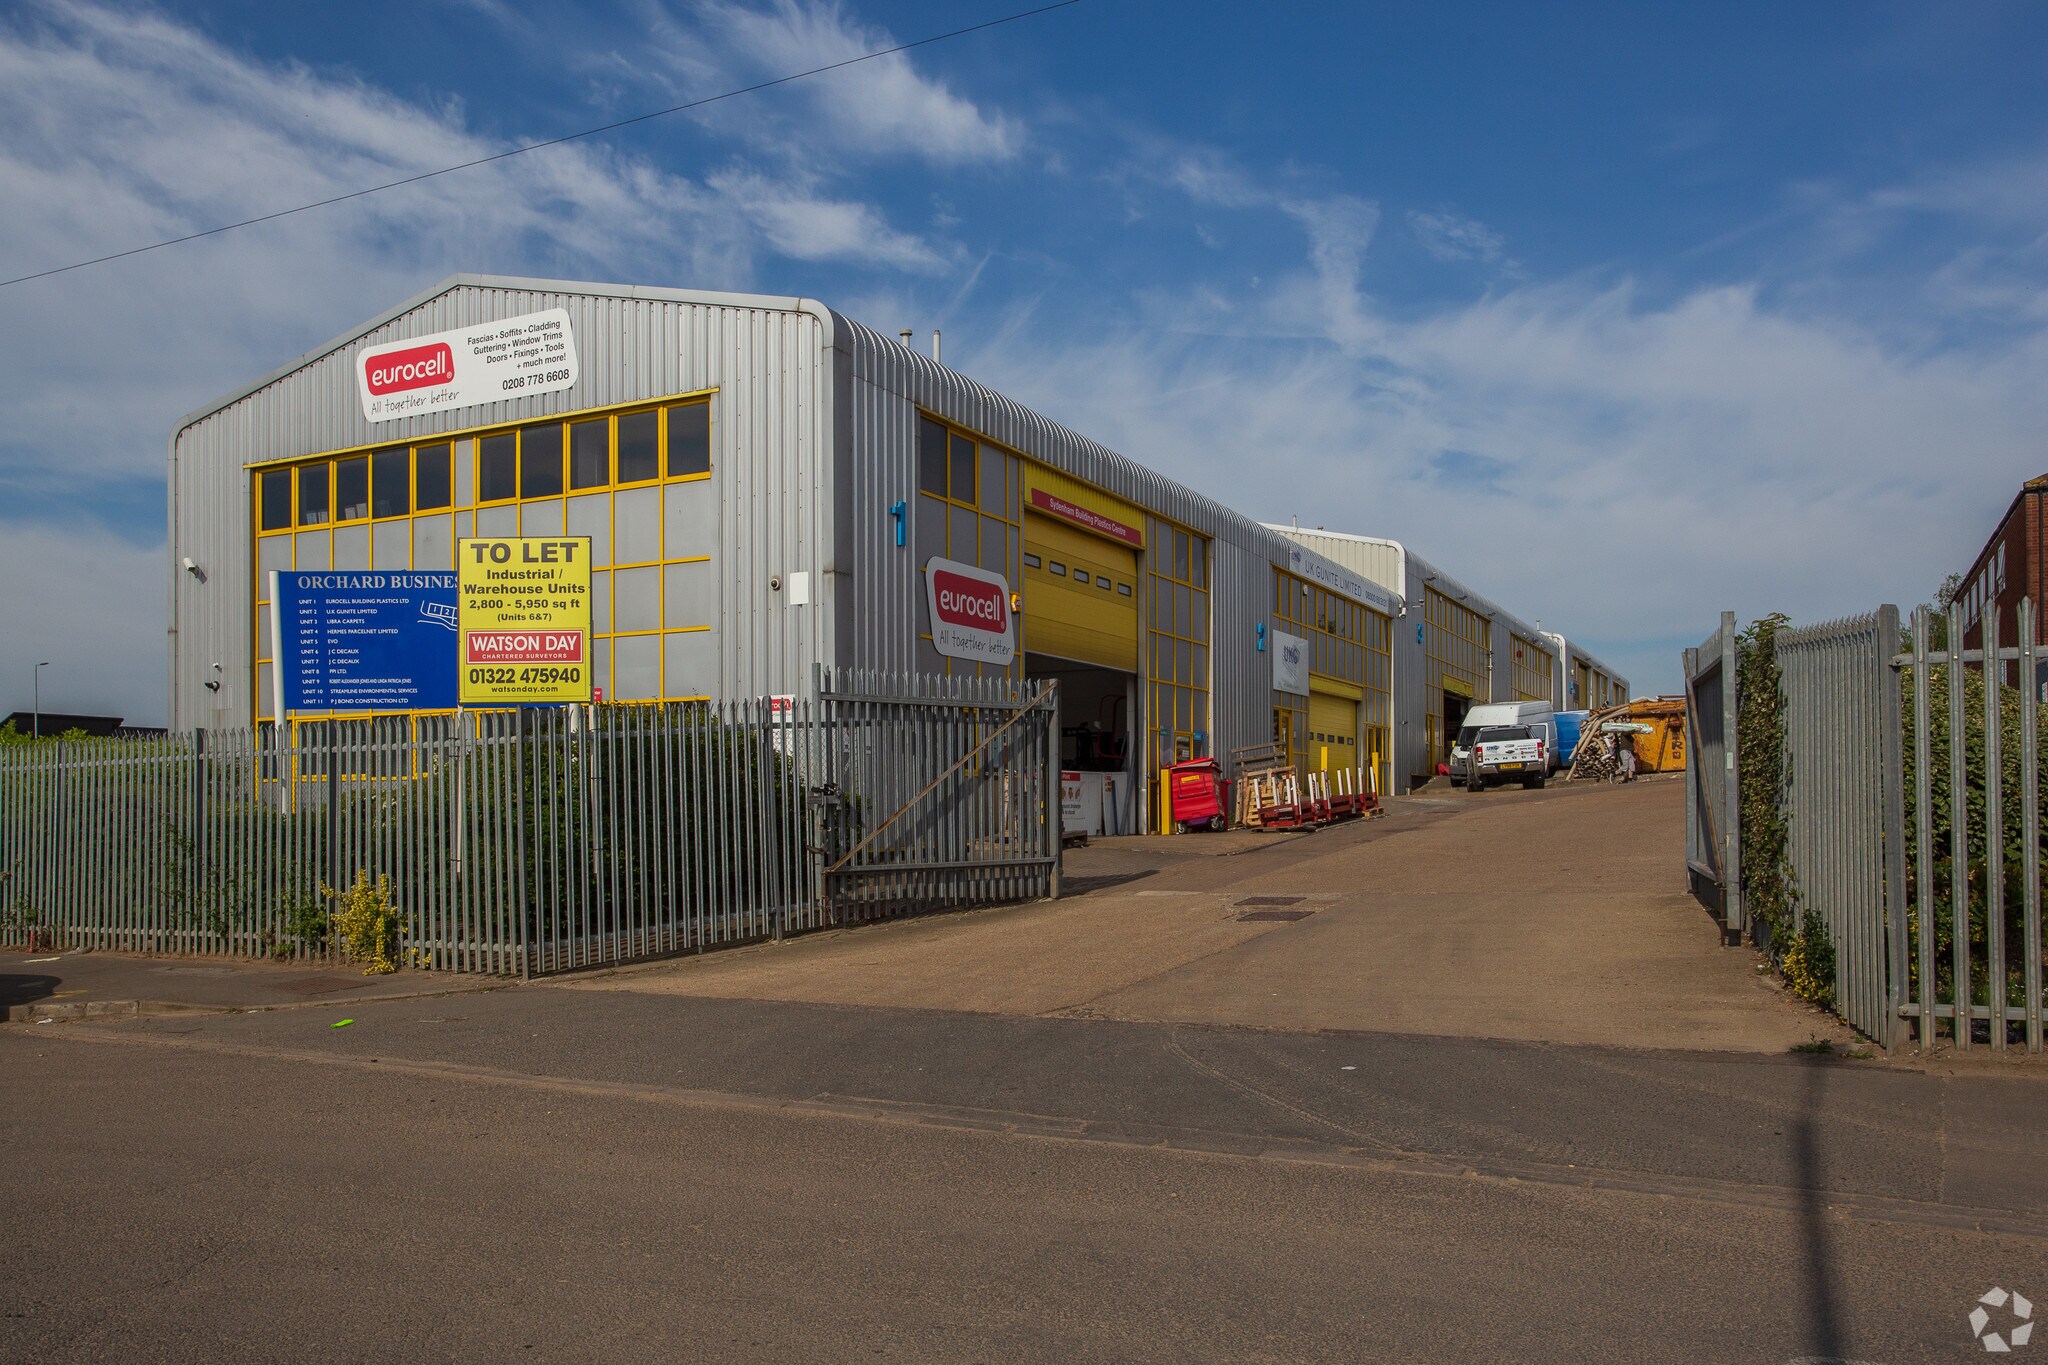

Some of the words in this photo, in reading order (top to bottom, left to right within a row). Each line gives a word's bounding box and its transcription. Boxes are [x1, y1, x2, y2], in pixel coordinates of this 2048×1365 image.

[467, 333, 494, 346] Fascias
[499, 328, 523, 340] Soffits
[528, 320, 561, 335] Cladding
[473, 342, 507, 356] Guttering
[512, 335, 541, 348] Window
[542, 331, 563, 342] Trims
[486, 353, 508, 364] Doors
[514, 346, 540, 360] Fixings
[545, 342, 565, 353] Tools
[522, 358, 544, 369] much
[544, 352, 566, 364] more!
[372, 350, 446, 387] eurocell
[502, 378, 526, 391] 0208
[527, 374, 544, 386] 778
[546, 368, 570, 382] 6608
[371, 402, 382, 415] All
[385, 394, 428, 412] together
[430, 389, 460, 404] better
[890, 501, 906, 547] 1
[1049, 498, 1075, 516] Sydenham
[1076, 508, 1094, 526] Building
[1094, 516, 1112, 531] Plastics
[1112, 524, 1126, 536] Centre
[470, 542, 511, 564] TO
[522, 542, 578, 562] LET
[298, 575, 386, 590] ORCHARD
[390, 575, 458, 588] BUSINE
[487, 569, 554, 580] Industrial
[1304, 560, 1316, 576] UK
[1316, 566, 1338, 587] GUNITE
[464, 584, 543, 594] Warehouse
[548, 584, 585, 594] Units
[470, 600, 503, 611] 2,800
[514, 599, 548, 610] 5,950
[552, 601, 567, 611] sq
[570, 599, 580, 608] ft
[940, 589, 1000, 622] eurocell
[498, 614, 526, 622] (Units
[529, 613, 552, 622] 6&7)
[472, 636, 540, 652] WATSON
[546, 635, 578, 651] DAY
[940, 630, 948, 645] All
[952, 629, 986, 652] together
[988, 636, 1010, 656] better
[469, 668, 516, 684] 01322
[520, 668, 580, 684] 475940
